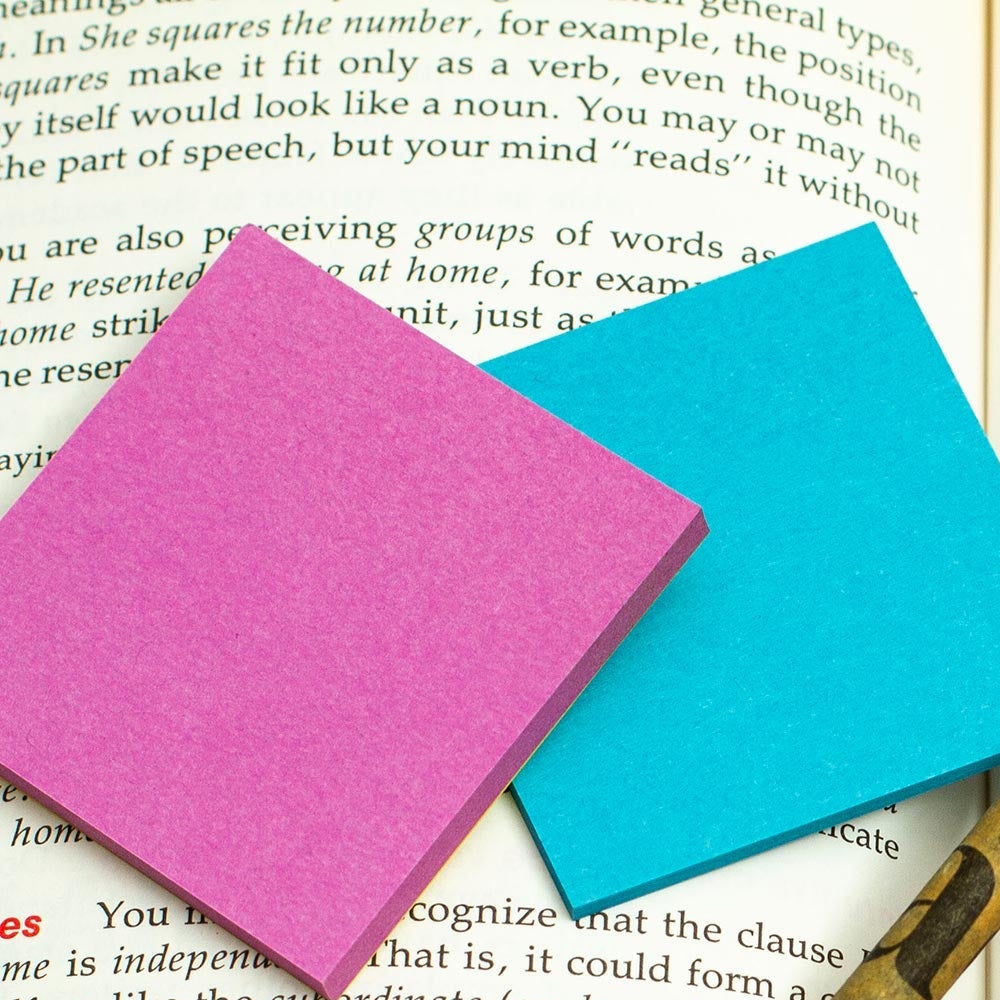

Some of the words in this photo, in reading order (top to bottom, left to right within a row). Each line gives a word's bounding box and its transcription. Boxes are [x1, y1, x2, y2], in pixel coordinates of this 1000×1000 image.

[79, 23, 138, 52] She
[146, 19, 271, 52] squares
[344, 7, 484, 37] number,
[559, 20, 721, 56] example,
[797, 49, 923, 113] position
[699, 0, 824, 32] general
[837, 15, 924, 76] types,
[34, 102, 120, 137] itself
[130, 94, 241, 127] would
[254, 90, 331, 119] look
[454, 98, 559, 120] noun.
[576, 95, 647, 126] You
[129, 56, 223, 87] make
[339, 48, 419, 83] only
[528, 54, 620, 86] verb,
[641, 67, 725, 94] even
[745, 74, 862, 126] though
[57, 147, 127, 184] part
[183, 132, 316, 172] speech,
[333, 131, 394, 158] but
[403, 138, 490, 166] your
[500, 137, 598, 164] mind
[799, 174, 919, 235] without
[115, 224, 185, 253] also
[413, 221, 535, 251] groups
[610, 230, 724, 260] words
[406, 255, 510, 289] home,
[529, 259, 583, 289] for
[472, 305, 544, 335] just
[96, 900, 170, 930] You
[662, 909, 722, 944] the
[737, 921, 844, 969] clause
[367, 938, 450, 969] That
[463, 941, 508, 977] is,
[567, 951, 672, 984] could
[686, 958, 776, 1000] form
